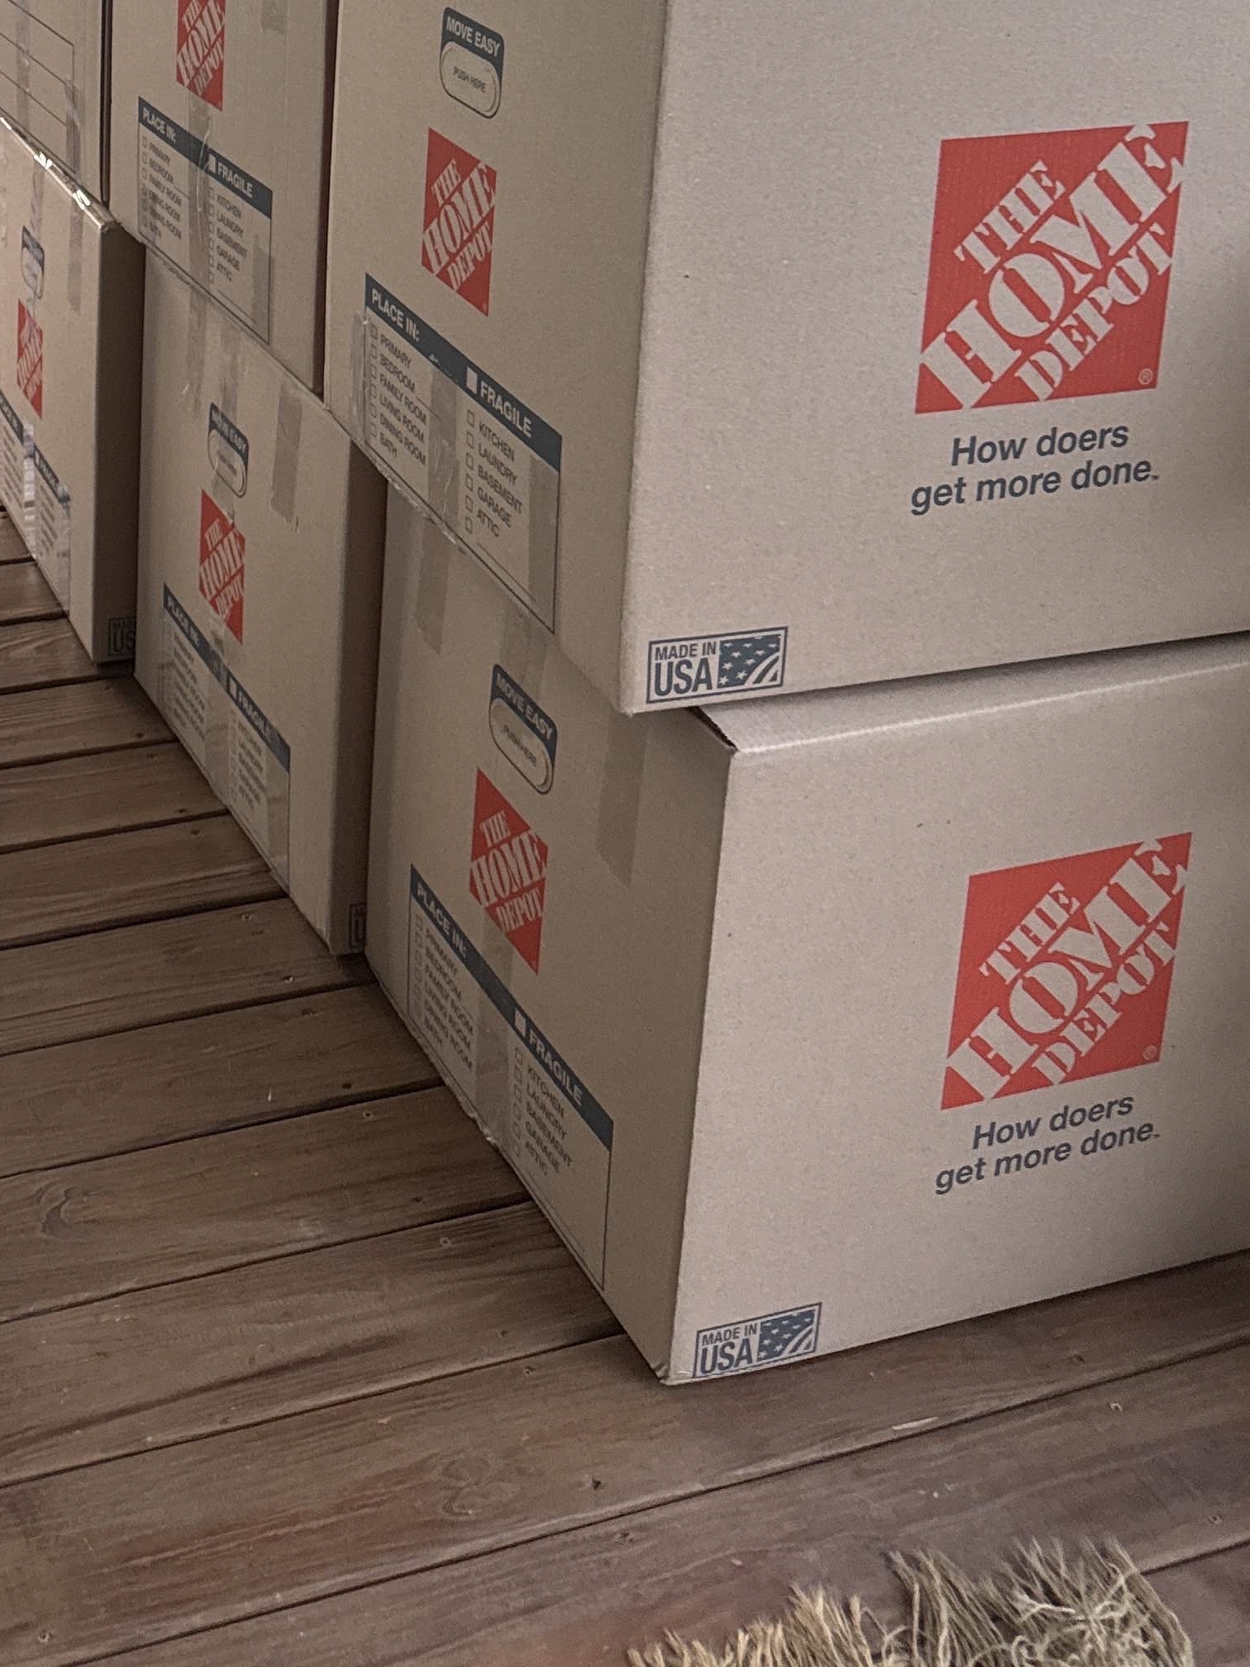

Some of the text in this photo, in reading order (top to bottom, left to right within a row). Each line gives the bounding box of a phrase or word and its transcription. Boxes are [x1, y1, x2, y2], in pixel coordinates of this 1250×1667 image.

[446, 16, 501, 57] MOVE EASY
[217, 162, 253, 199] FRAGILE
[431, 159, 462, 208] THE
[422, 161, 497, 277] HOME
[953, 159, 1066, 275] THE
[447, 220, 493, 292] DEPOT
[921, 124, 1185, 409] HOME
[371, 289, 420, 342] PLACE IN:
[1014, 222, 1174, 402] DEPOT
[380, 354, 416, 394] BEDROOM
[402, 415, 425, 445] ROOM
[403, 396, 428, 426] ROOM
[480, 382, 533, 439] FRAGILE
[403, 435, 427, 466] ROOM
[478, 422, 515, 463] KITCHEN
[478, 443, 517, 485] LAUNDRY
[952, 424, 1129, 467] How doers
[477, 487, 512, 528] GARAGE
[478, 465, 523, 514] BASEMENT
[910, 458, 1160, 516] get more done.
[477, 507, 500, 538] ATTIC
[200, 526, 245, 602] HOME
[655, 641, 717, 661] MADE IN
[496, 673, 525, 711] MOVE
[654, 658, 713, 697] USA
[479, 810, 511, 848] THE
[471, 832, 548, 908] HOME
[417, 882, 450, 936] PLACE
[495, 886, 543, 934] DEPOT
[979, 882, 1081, 985] THE
[946, 838, 1188, 1101] HOME
[1031, 921, 1175, 1086] DEPOT
[528, 1028, 584, 1108] FRAGILE
[972, 1096, 1134, 1150] How doers
[935, 1122, 1161, 1196] get more done.
[700, 1337, 753, 1374] USA
[701, 1323, 758, 1347] MADE IN
